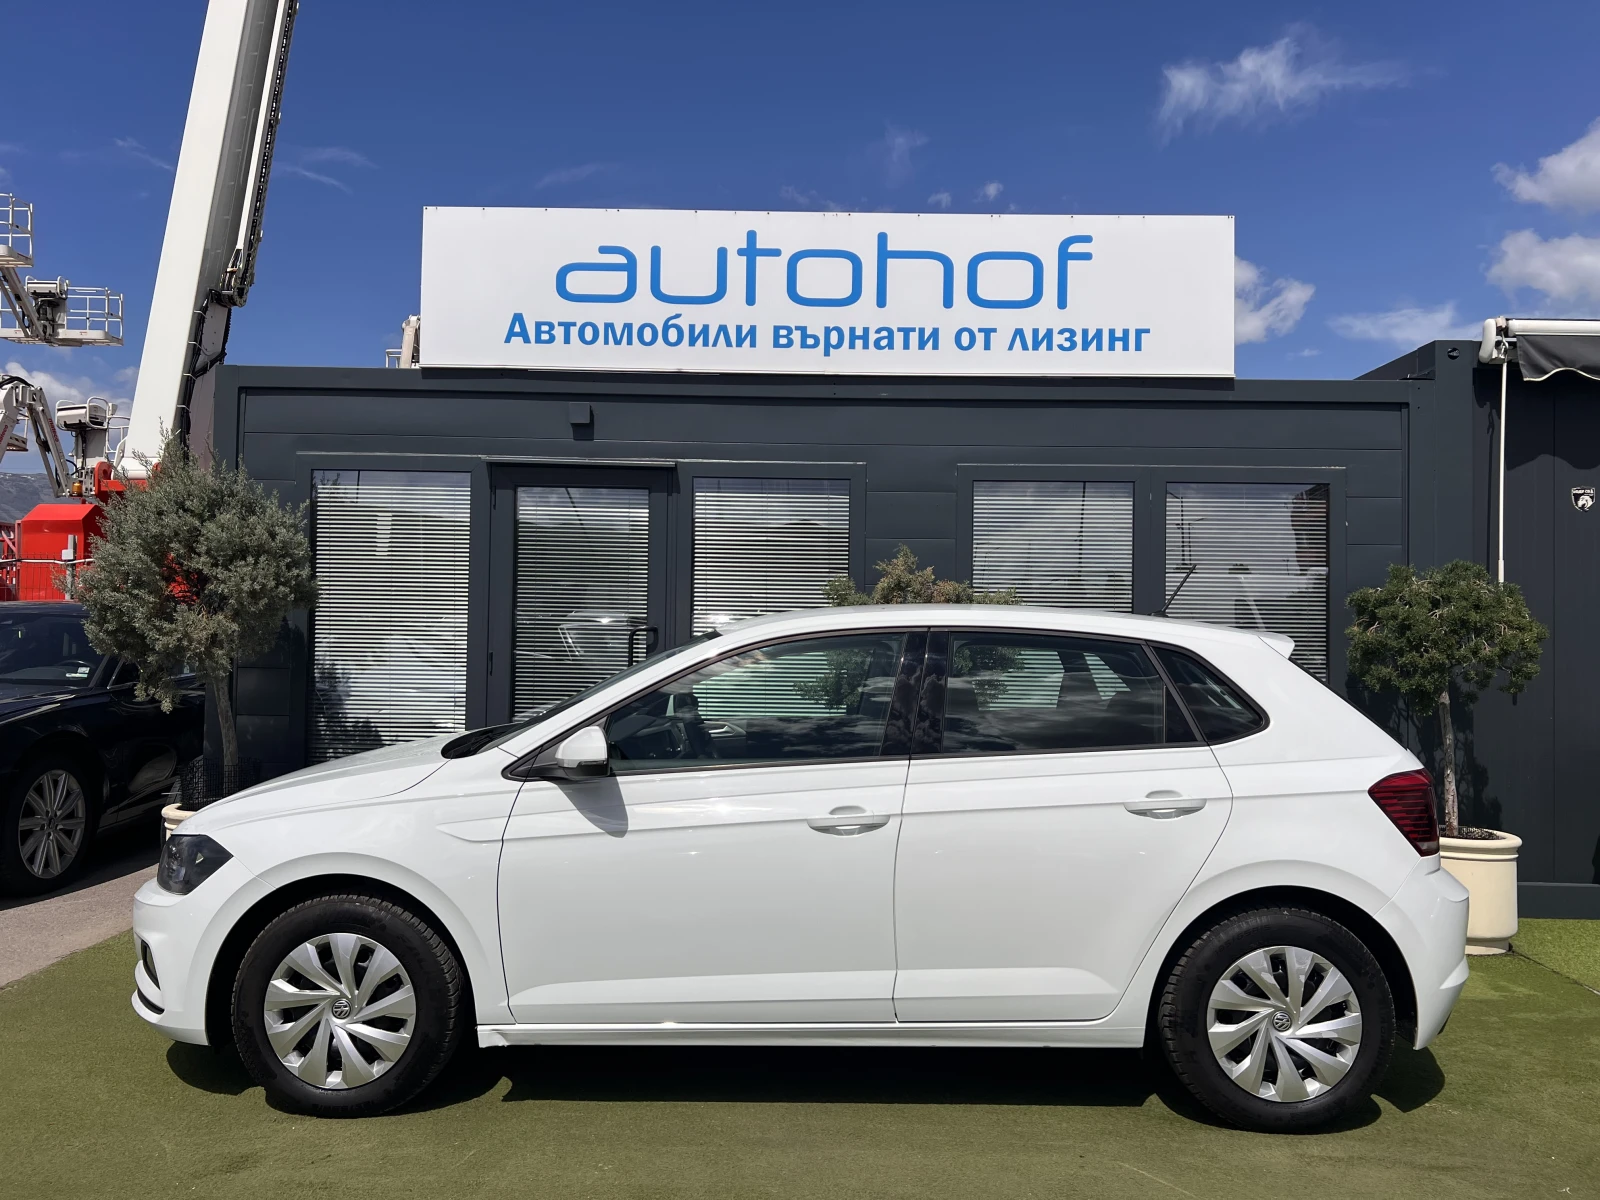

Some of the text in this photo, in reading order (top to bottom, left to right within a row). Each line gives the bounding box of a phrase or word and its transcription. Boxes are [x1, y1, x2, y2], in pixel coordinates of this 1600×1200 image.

[555, 229, 1094, 311] autohof
[504, 312, 1151, 357] Автомобили върнати от лизинг
